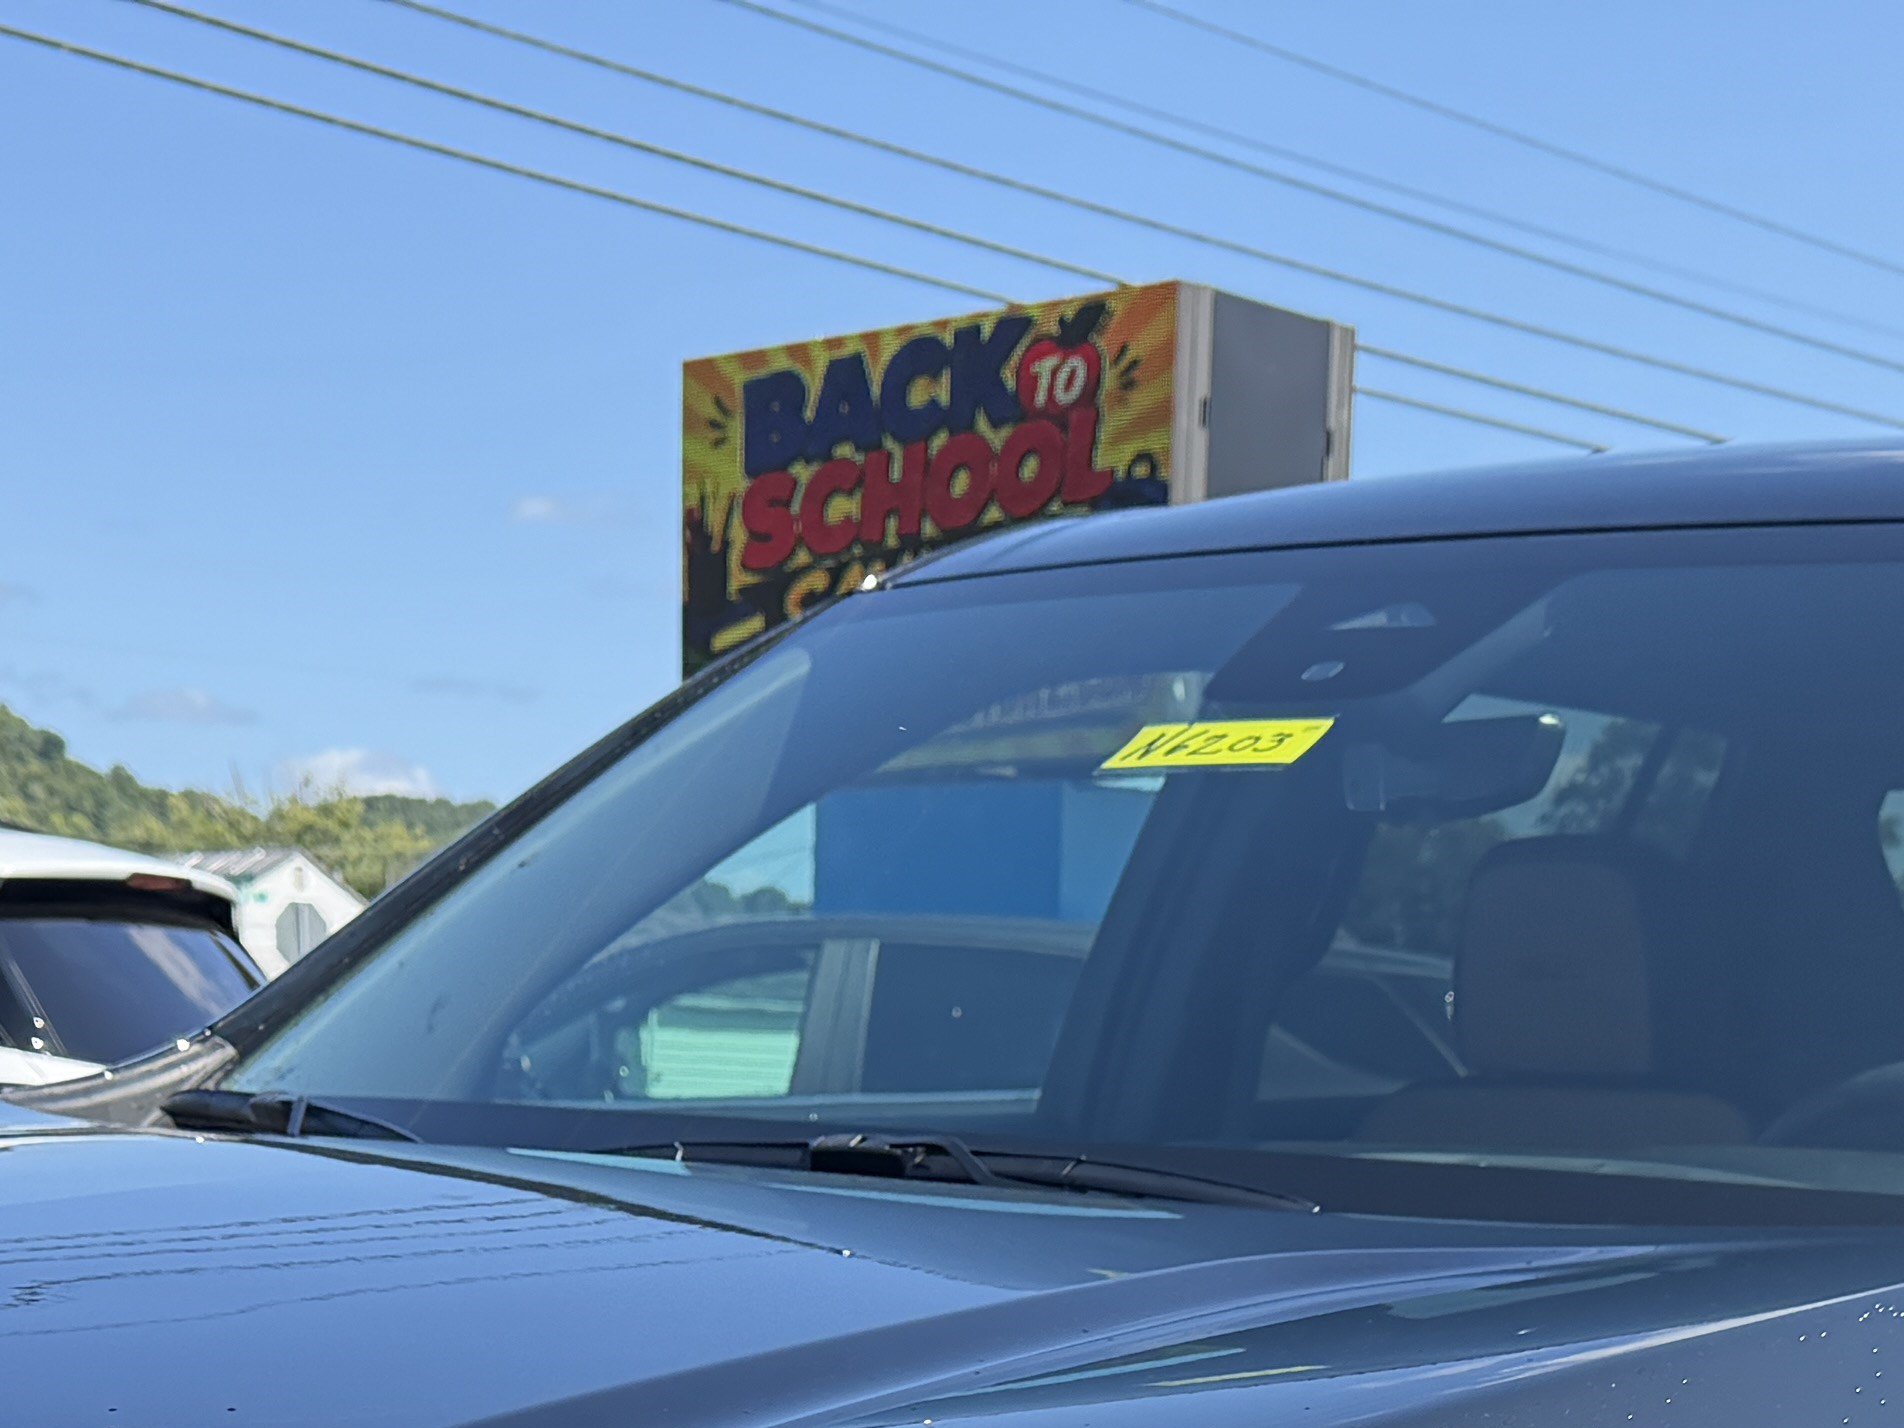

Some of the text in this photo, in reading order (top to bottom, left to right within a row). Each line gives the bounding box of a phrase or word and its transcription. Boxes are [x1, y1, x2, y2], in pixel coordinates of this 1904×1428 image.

[741, 315, 1089, 479] BACK TO
[740, 404, 1115, 570] SCHOOL
